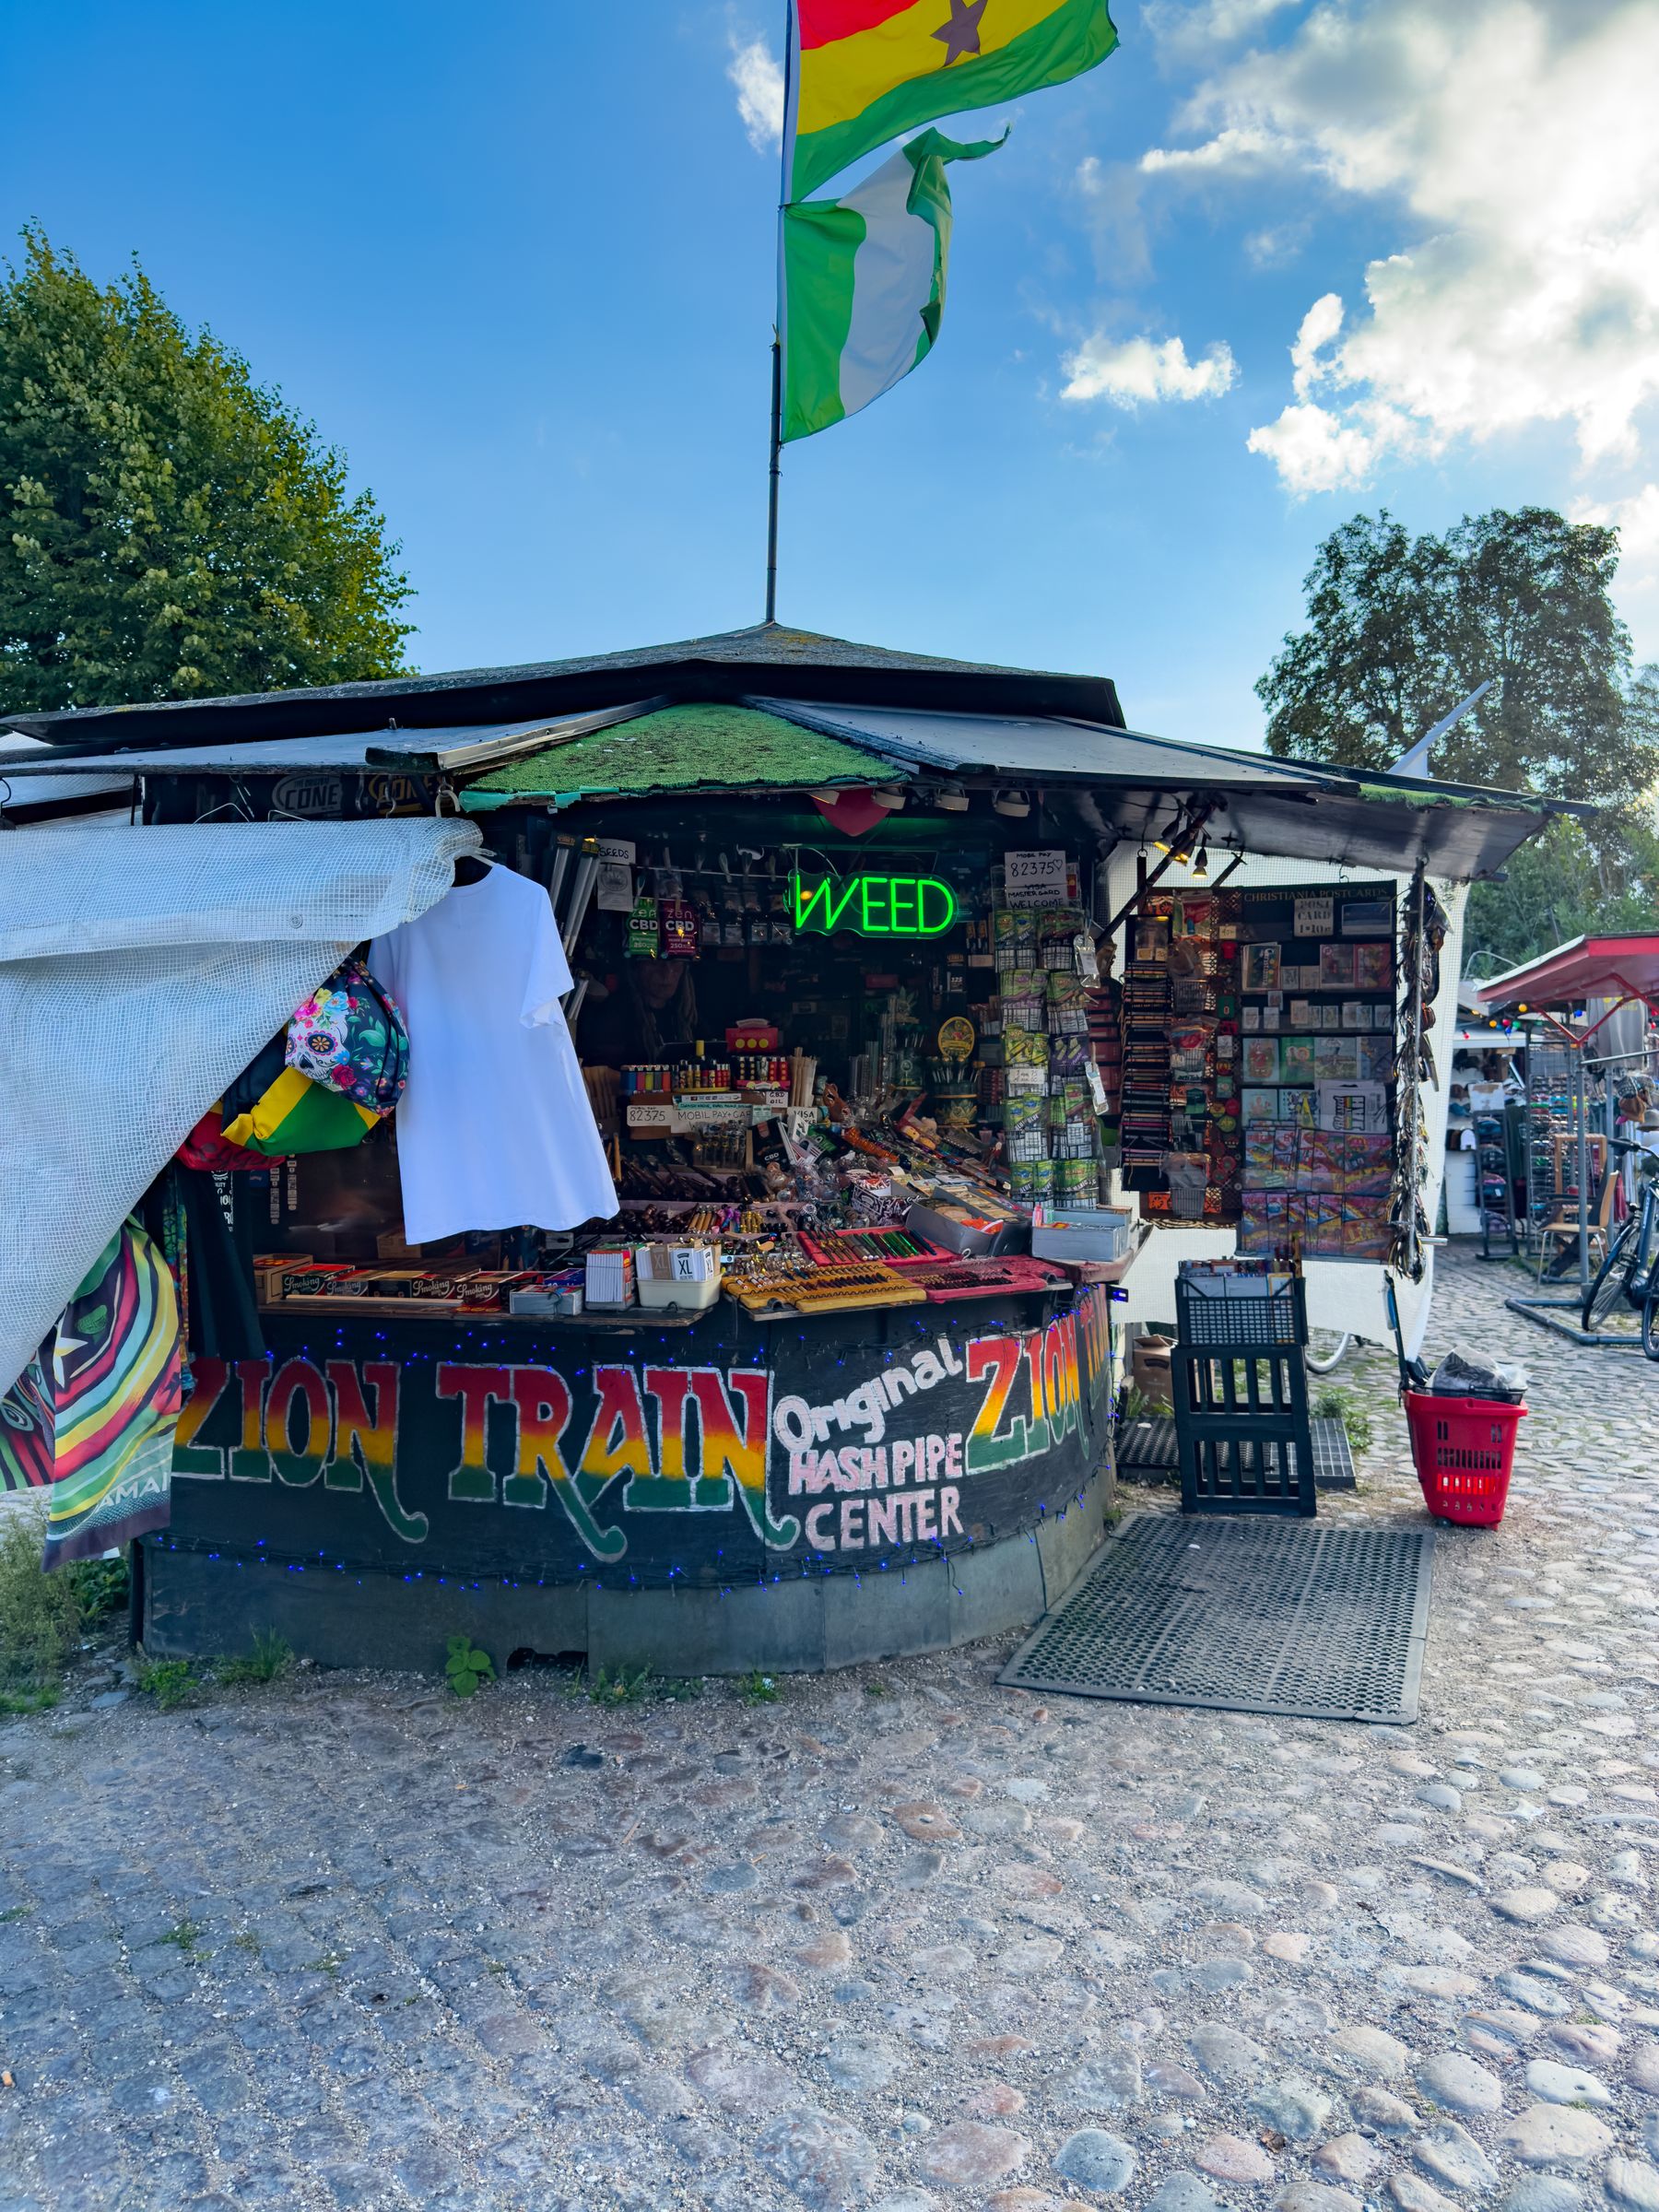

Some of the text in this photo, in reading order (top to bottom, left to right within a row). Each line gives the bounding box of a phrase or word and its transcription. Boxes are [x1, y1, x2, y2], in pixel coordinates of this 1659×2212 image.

[286, 783, 339, 810] CONE
[599, 847, 629, 859] SEEDS
[1010, 862, 1054, 877] 82375
[1244, 888, 1387, 901] CHRISTIANIA POSTCARDS
[795, 874, 954, 934] WEED
[1010, 898, 1063, 909] WELCOME
[1300, 900, 1329, 909] POST
[1297, 911, 1331, 920] CARD
[629, 919, 658, 931] CBD
[665, 920, 694, 931] CBD
[629, 1110, 666, 1122] 82375
[677, 1111, 710, 1121] MOBIL
[764, 1152, 779, 1160] CBD
[654, 1253, 668, 1269] XL
[678, 1259, 692, 1275] XL
[706, 1258, 713, 1273] XL
[284, 1275, 320, 1292] Smoking
[326, 1278, 361, 1296] Smoking
[413, 1277, 451, 1297] Smoking
[457, 1282, 493, 1299] Smoking
[773, 1335, 965, 1451] Original
[965, 1312, 1089, 1477] ZION
[172, 1355, 800, 1563] ZION TRAIN
[787, 1432, 964, 1495] HASH PIPE
[805, 1489, 965, 1551] CENTER
